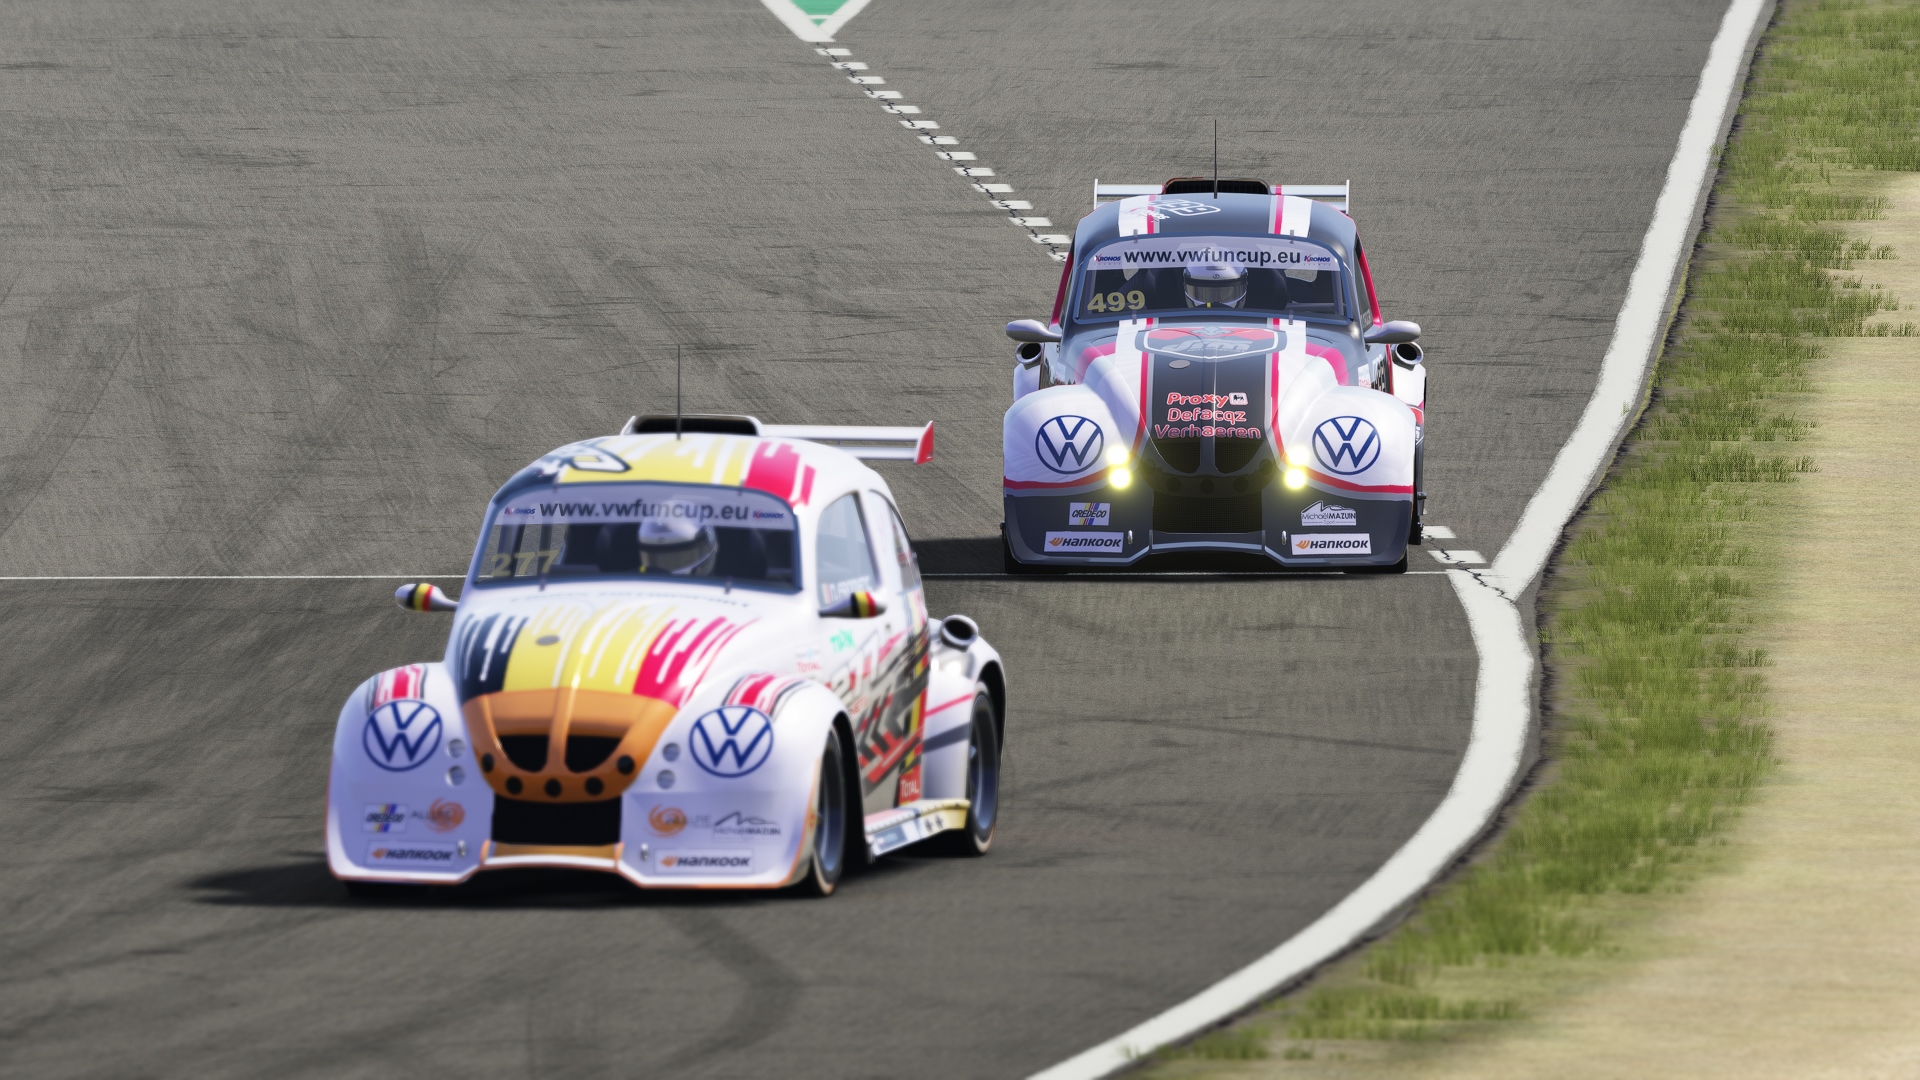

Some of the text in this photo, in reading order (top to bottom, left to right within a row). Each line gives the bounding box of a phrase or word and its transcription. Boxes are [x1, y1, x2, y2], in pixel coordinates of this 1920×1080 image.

[1124, 246, 1301, 268] www.vwfuncup.eu
[1303, 254, 1330, 263] KRONOS
[1087, 289, 1146, 312] 499
[1166, 392, 1229, 407] Proxy
[1167, 407, 1246, 425] Defacqz
[1154, 424, 1262, 439] Verhaeren
[540, 499, 749, 521] www.vwfuncup.eu
[1071, 509, 1107, 518] CREDECO
[491, 549, 560, 577] 277
[900, 778, 920, 798] TOTAL
